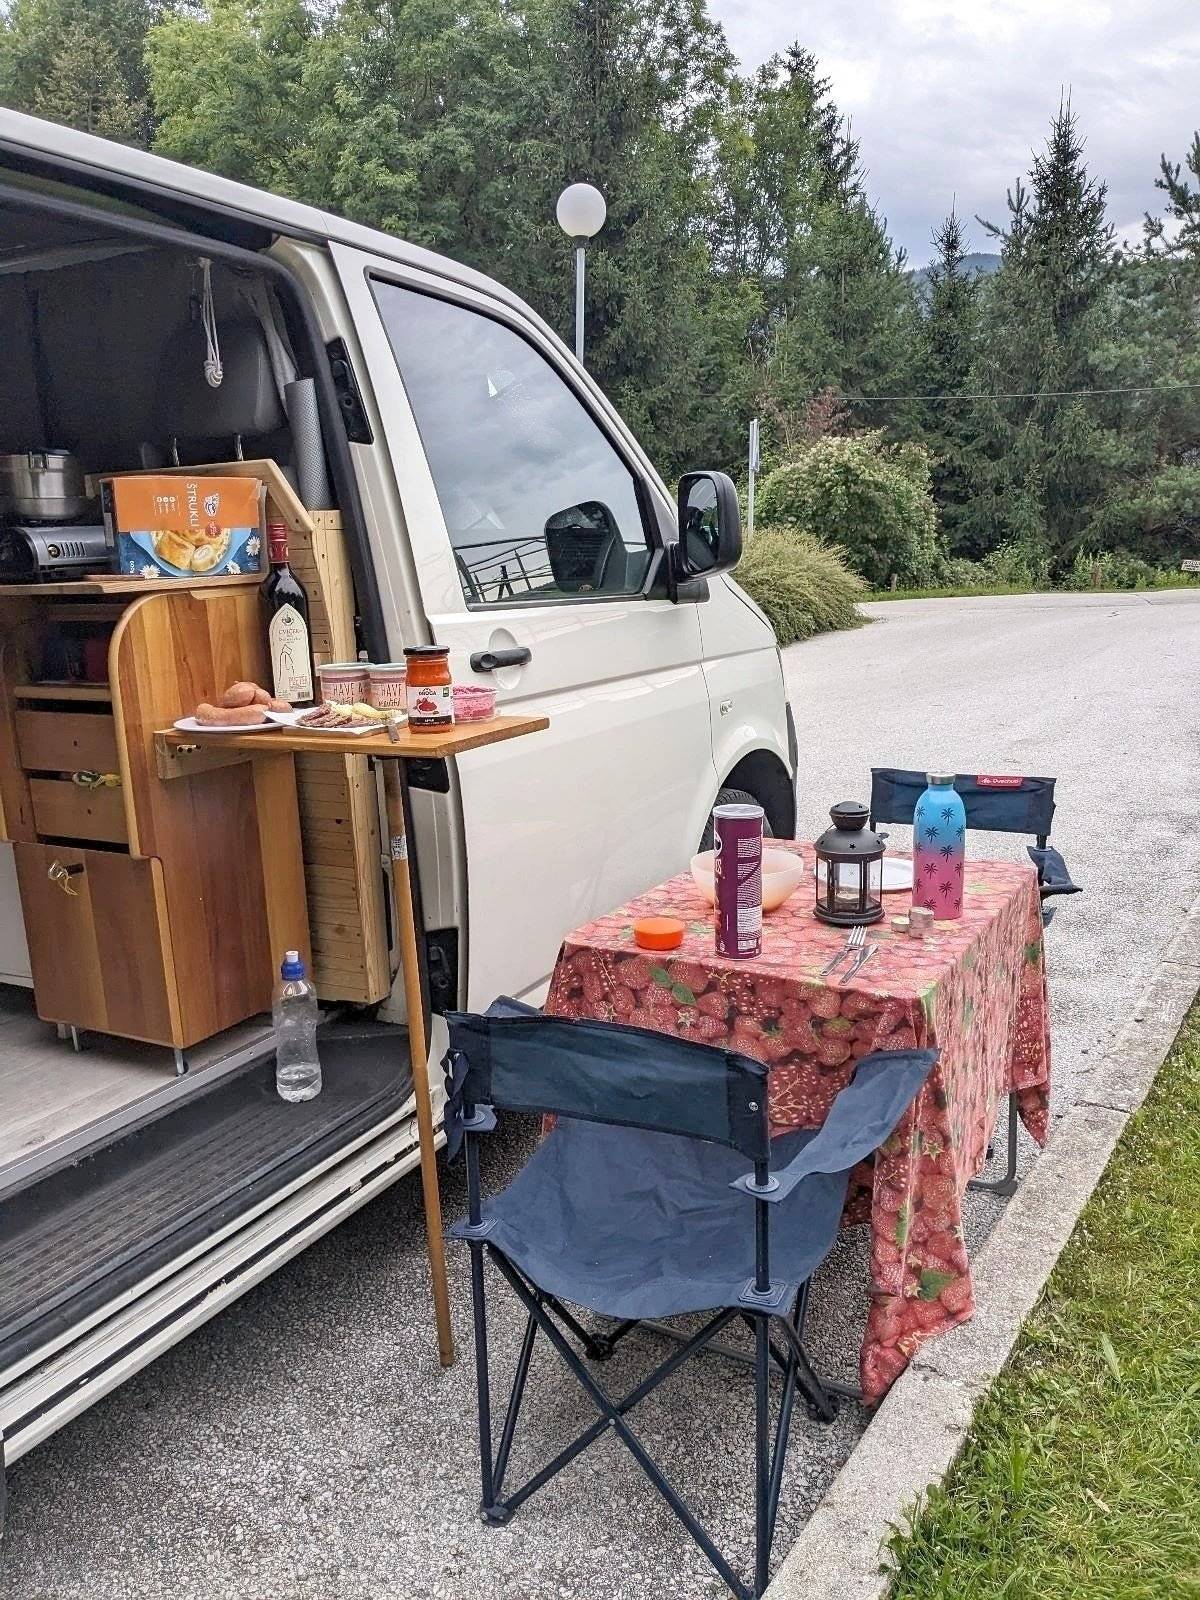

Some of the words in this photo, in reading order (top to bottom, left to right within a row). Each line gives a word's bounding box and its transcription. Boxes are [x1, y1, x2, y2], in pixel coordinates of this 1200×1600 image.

[333, 682, 355, 696] HAVE
[358, 682, 364, 695] A
[381, 684, 402, 697] HAVE
